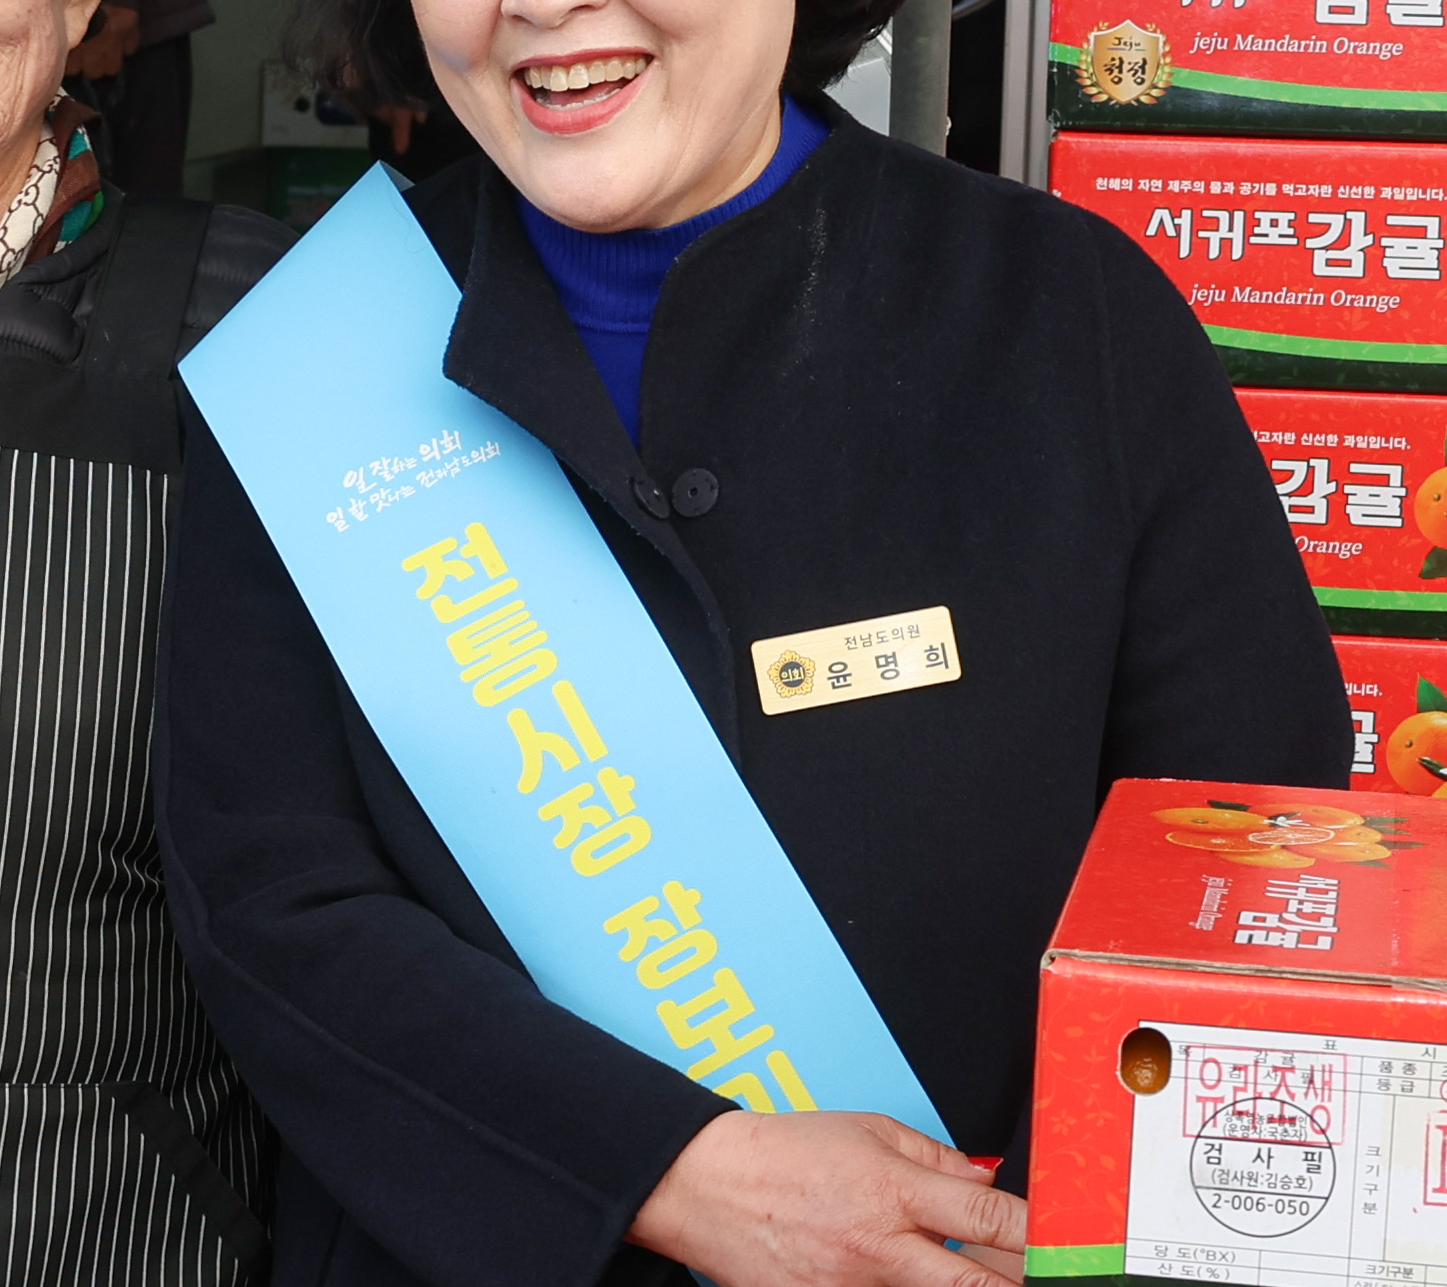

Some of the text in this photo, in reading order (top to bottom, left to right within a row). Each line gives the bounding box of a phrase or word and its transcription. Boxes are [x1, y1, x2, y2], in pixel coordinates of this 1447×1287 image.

[1113, 35, 1142, 49] Jeju
[1190, 34, 1403, 59] jeju Mandarin Orange
[1101, 55, 1148, 87] 청정
[1095, 177, 1133, 192] 천혜의
[1138, 178, 1163, 193] 자연
[1167, 179, 1205, 194] 제주의
[1239, 181, 1278, 196] 공기를
[1282, 181, 1333, 198] 먹고자란
[1337, 183, 1376, 199] 신선한
[1189, 285, 1400, 312] jeju Mandarin Orange
[1253, 431, 1412, 451] 고자란 신선한 과일입니다.
[343, 429, 462, 494] 일 잘하는 의회
[416, 440, 501, 488] 전라남도의회
[1295, 535, 1362, 558] Orange
[844, 624, 921, 651] 전남도의원
[781, 667, 804, 682] 의회
[400, 521, 655, 879] 전통시장
[1211, 1168, 1314, 1193] (검사원:김승호)
[1211, 1193, 1310, 1217] 2-006-050
